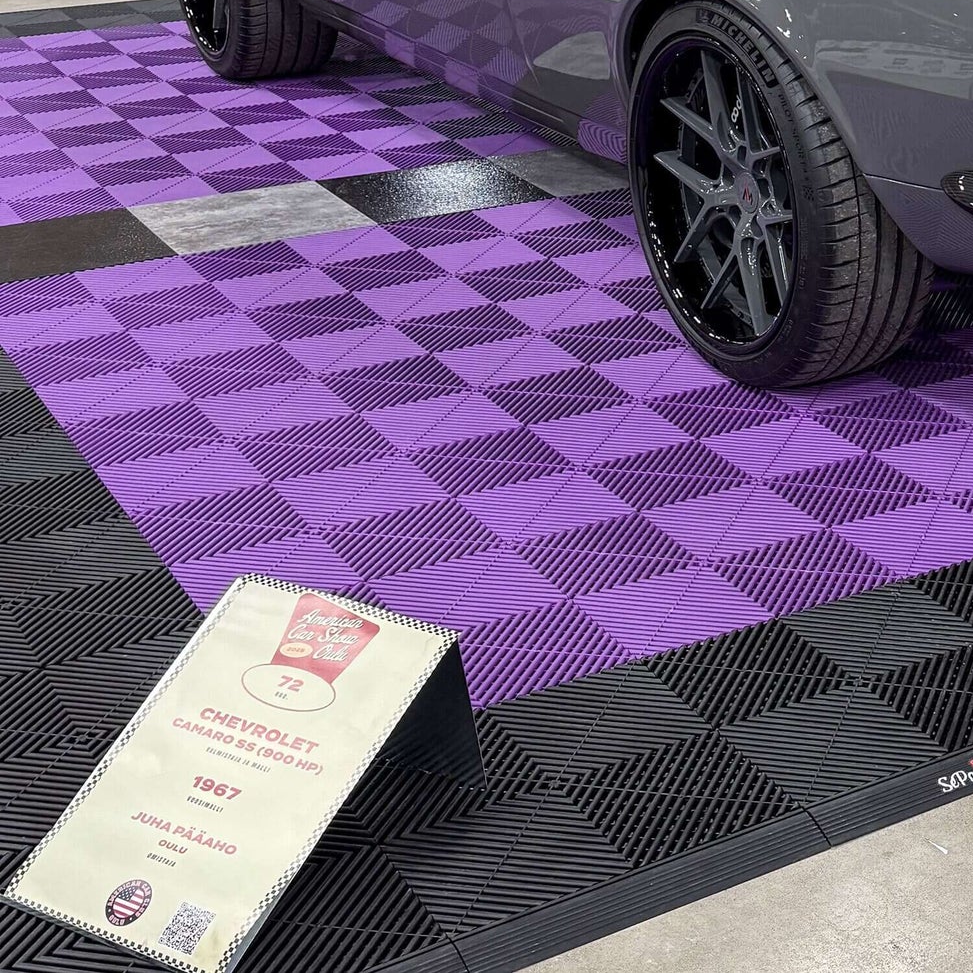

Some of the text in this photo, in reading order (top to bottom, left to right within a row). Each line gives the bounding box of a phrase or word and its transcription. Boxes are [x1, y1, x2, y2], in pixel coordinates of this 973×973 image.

[711, 13, 775, 85] MICHELIN
[297, 609, 364, 629] American
[287, 623, 359, 644] Car Show
[278, 675, 305, 692] 72
[200, 707, 320, 754] CHEVROLET
[172, 717, 324, 776] CAMARO SS (900 HP)
[193, 775, 242, 800] 1967
[131, 811, 238, 856] JUHA PÄÄAHO
[158, 839, 188, 855] OULU
